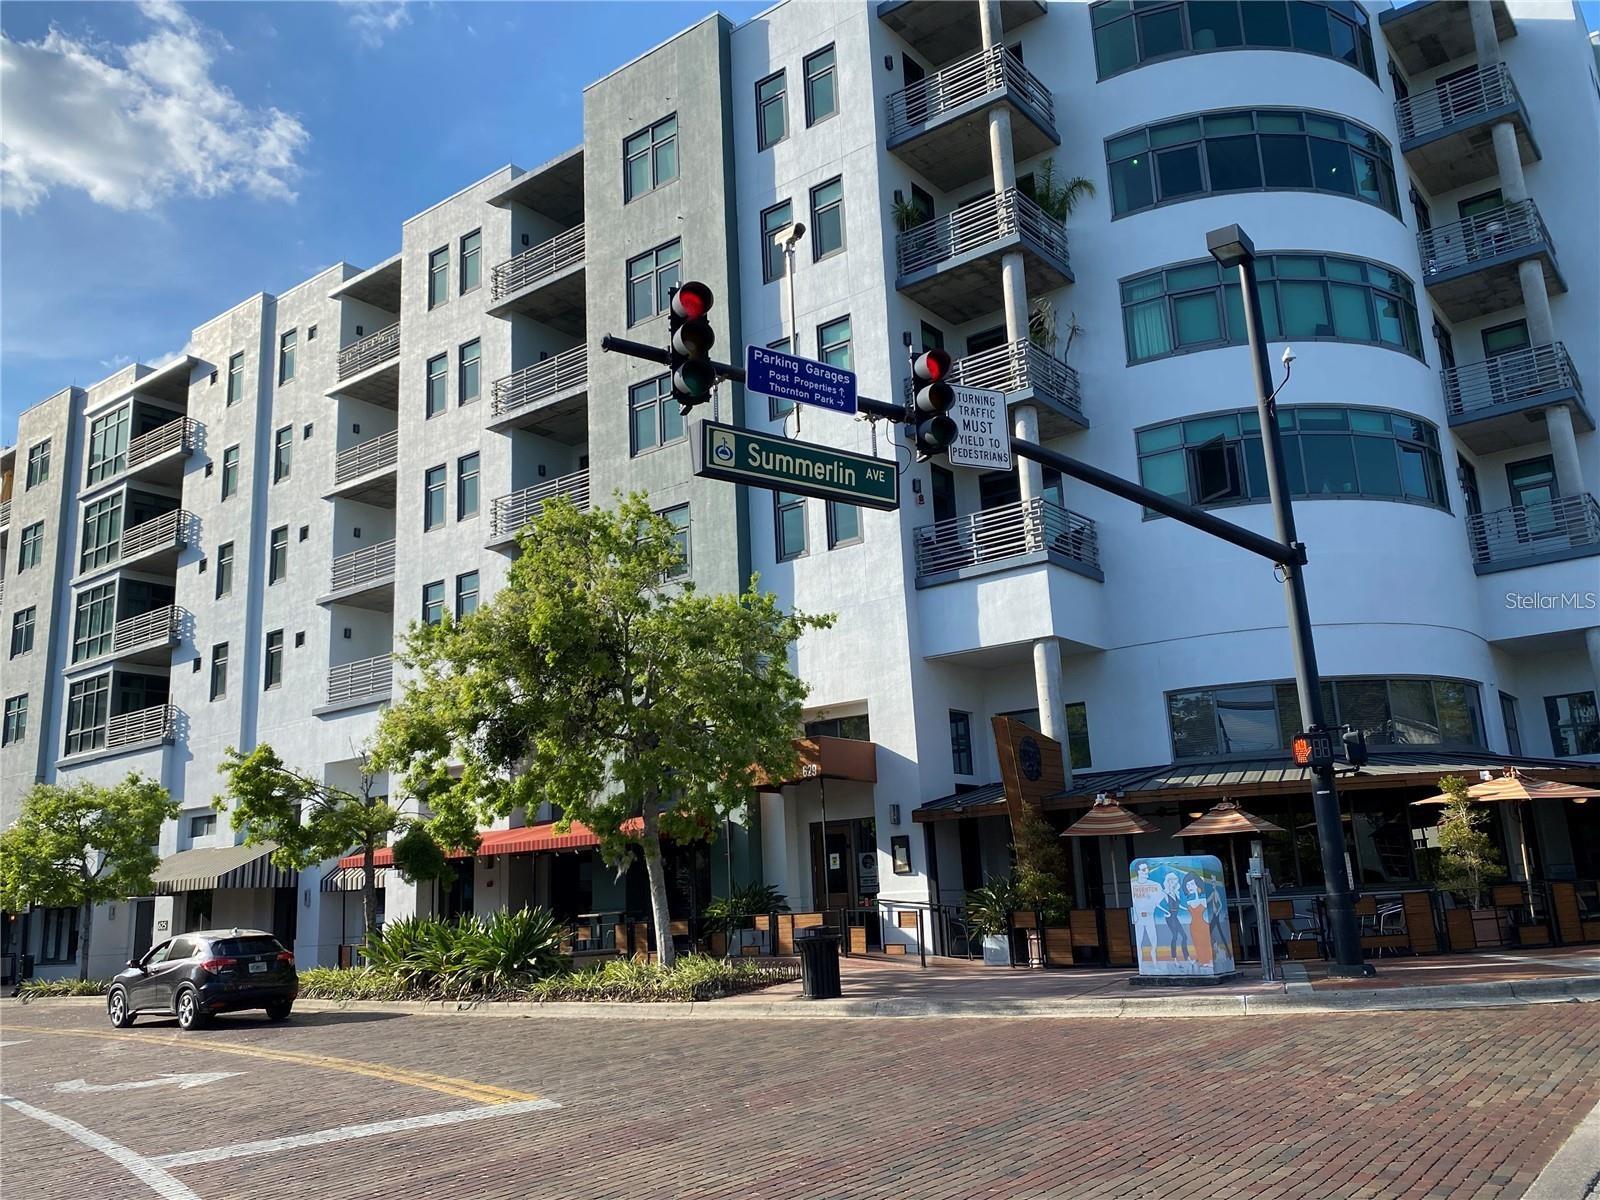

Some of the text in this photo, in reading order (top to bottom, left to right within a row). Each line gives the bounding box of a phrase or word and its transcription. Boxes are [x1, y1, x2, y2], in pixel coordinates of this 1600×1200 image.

[754, 349, 850, 384] Parking Garages
[769, 370, 837, 394] Post Properties
[769, 382, 834, 405] Thornton Park
[957, 392, 996, 407] TURNING
[959, 405, 996, 419] TRAFFIC
[963, 419, 993, 434] MUST
[959, 434, 1001, 449] YIELD TO
[953, 447, 1009, 463] PEDESTRIANS
[748, 443, 886, 486] Summerlin AVE
